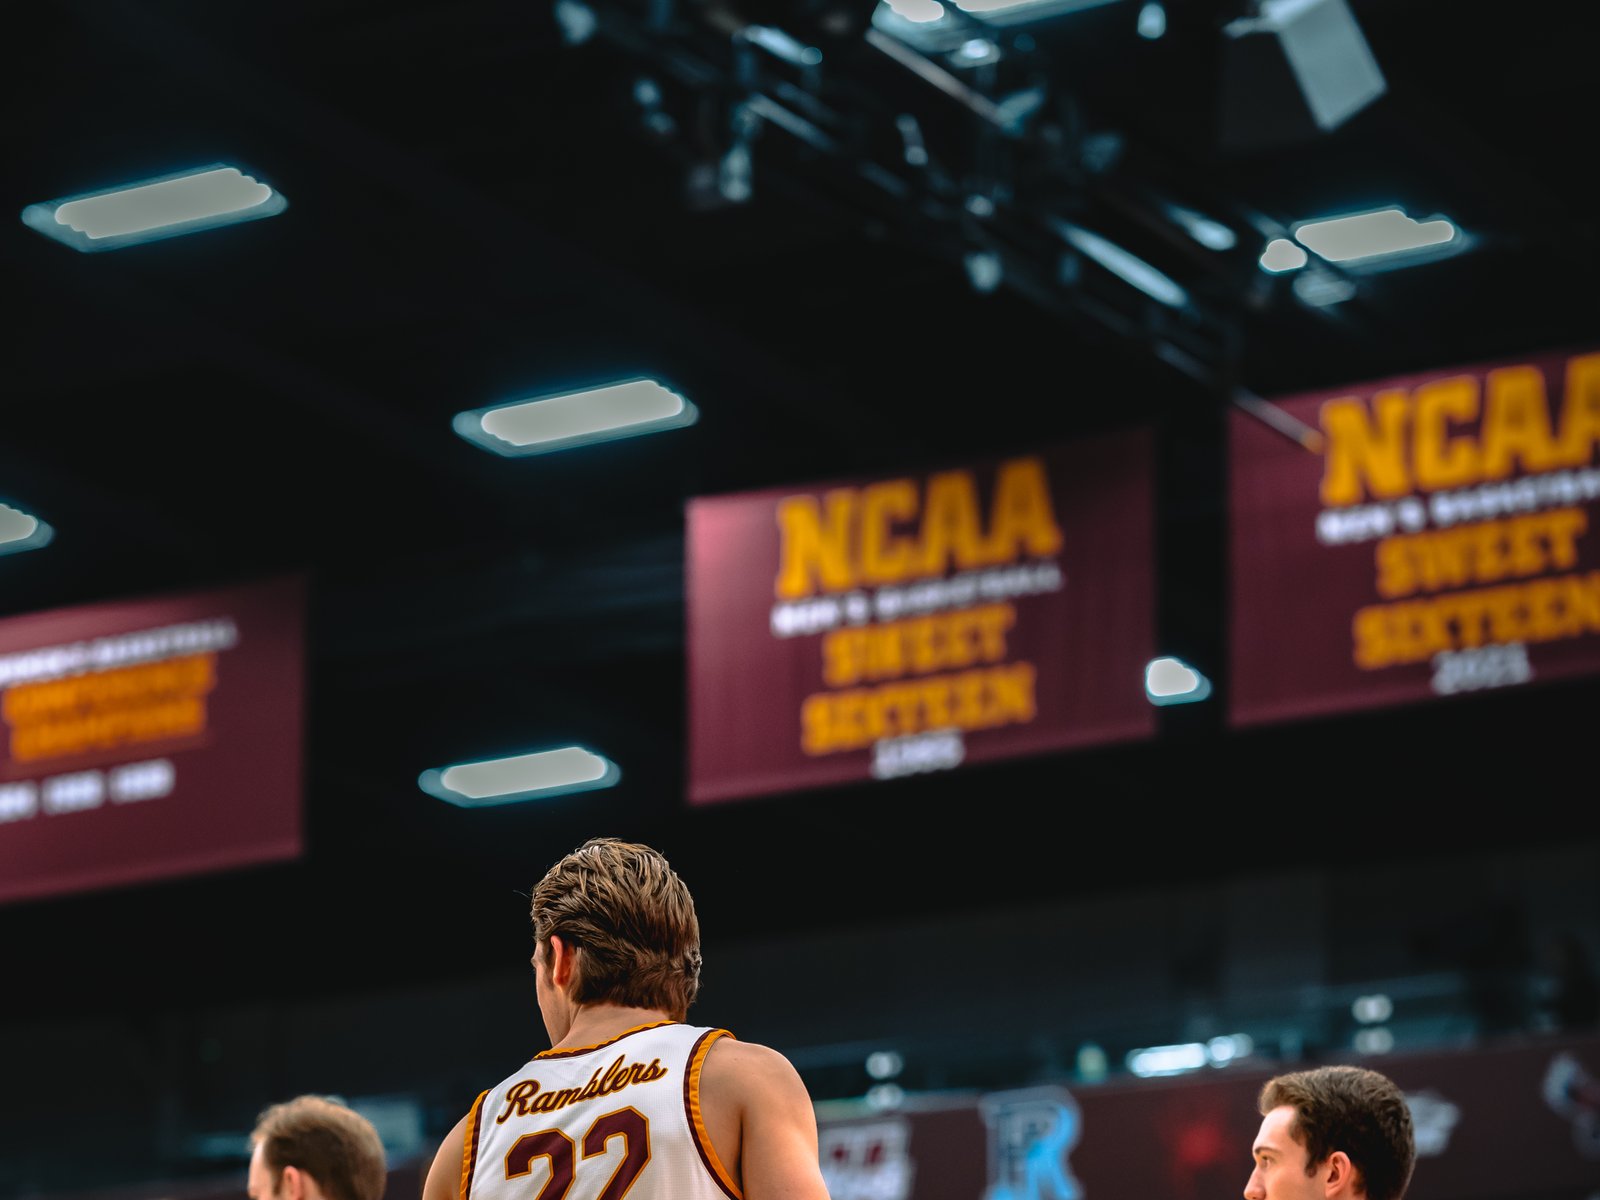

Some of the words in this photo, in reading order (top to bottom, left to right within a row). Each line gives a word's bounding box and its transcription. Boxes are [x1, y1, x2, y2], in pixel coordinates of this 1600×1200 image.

[778, 457, 1062, 598] NCAA
[1376, 507, 1586, 599] SWEET
[823, 603, 1014, 686] SWEET
[802, 662, 1035, 755] SIXTEEN
[496, 1054, 668, 1125] Ramblers
